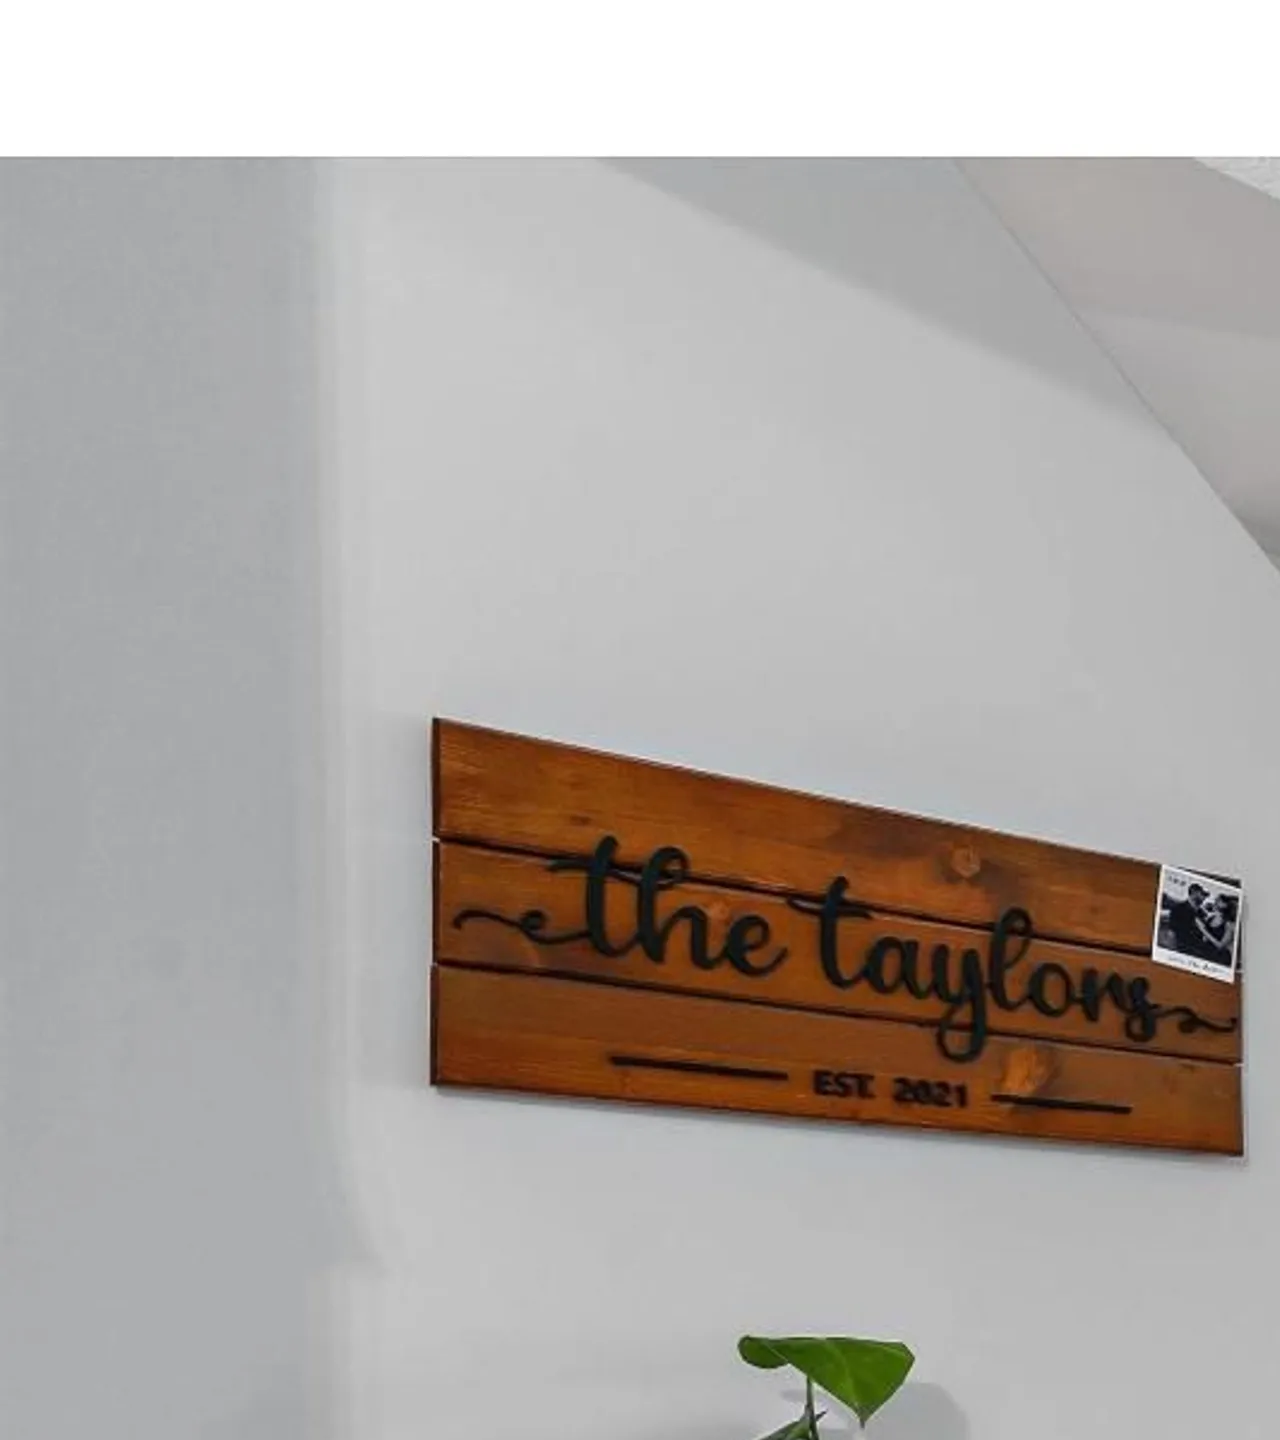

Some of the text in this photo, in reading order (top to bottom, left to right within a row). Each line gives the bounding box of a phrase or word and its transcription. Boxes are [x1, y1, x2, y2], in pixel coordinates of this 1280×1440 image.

[453, 834, 1237, 1063] the taylors
[893, 1076, 968, 1108] 2021
